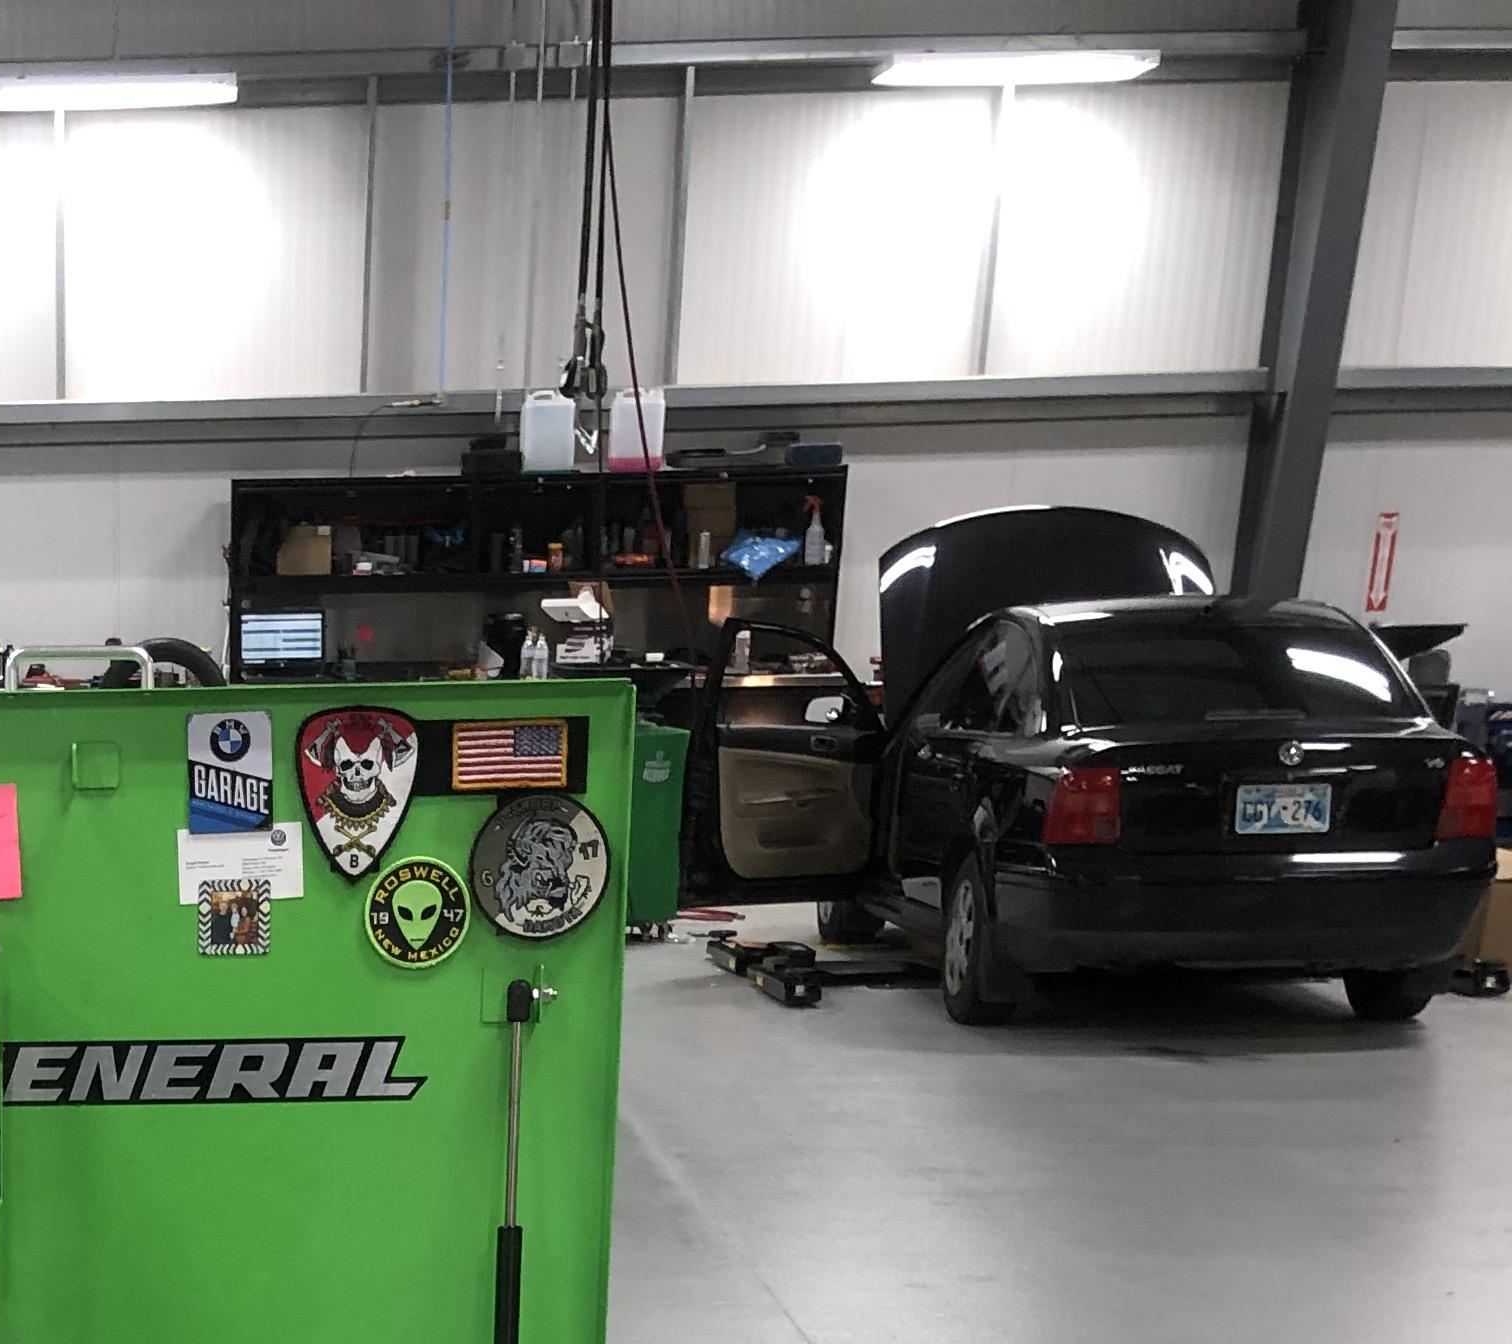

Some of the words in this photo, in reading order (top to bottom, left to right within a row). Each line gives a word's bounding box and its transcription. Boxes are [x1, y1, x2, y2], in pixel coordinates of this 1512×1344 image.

[212, 721, 249, 735] BMW
[194, 764, 270, 814] GARAGE
[579, 840, 600, 860] 17
[375, 866, 459, 904] ROSWELL
[481, 870, 494, 887] 6
[371, 912, 389, 925] 19
[443, 908, 464, 922] 47
[375, 929, 402, 956] NEW
[408, 927, 460, 961] MEXICO
[1, 1038, 427, 1103] ENERAL
